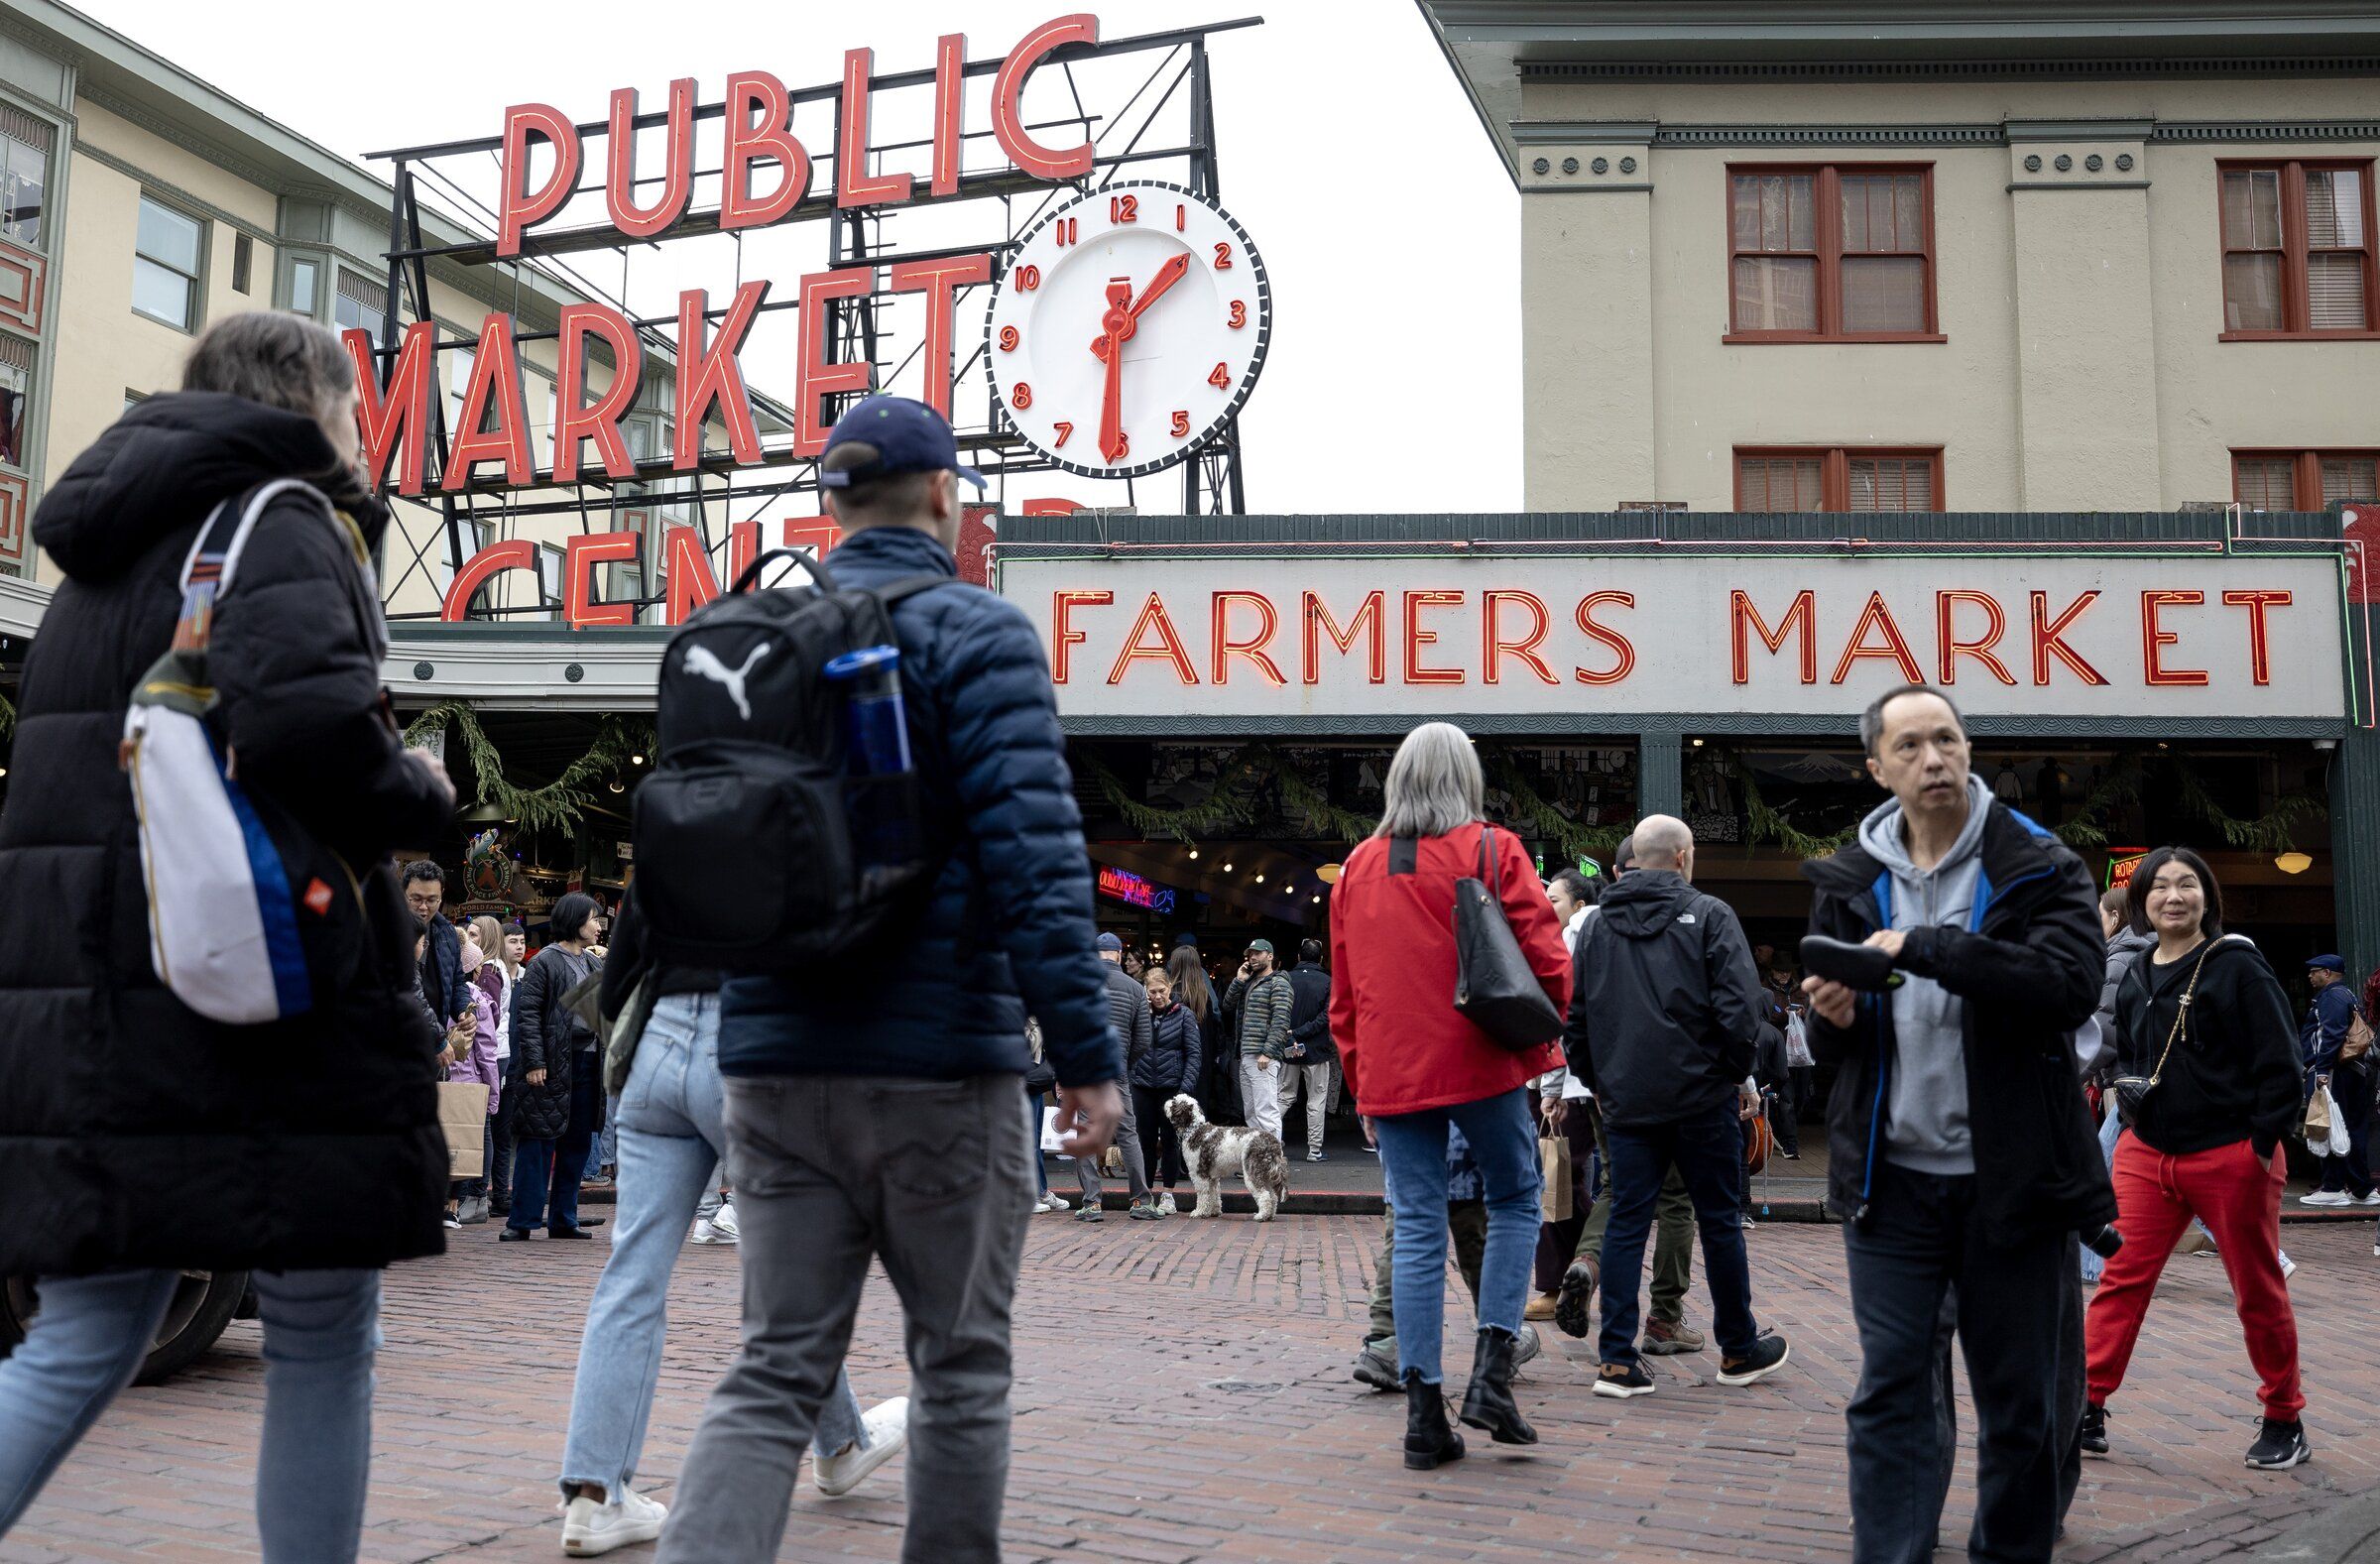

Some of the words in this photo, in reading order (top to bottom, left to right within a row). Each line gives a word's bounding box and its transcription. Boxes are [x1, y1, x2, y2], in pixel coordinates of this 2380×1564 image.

[497, 13, 1100, 257] PUBLIC
[1110, 194, 1138, 223] 12
[1176, 203, 1185, 232] 1
[1056, 217, 1077, 247] 11
[1214, 242, 1233, 271] 2
[1014, 264, 1040, 294] 10
[1227, 300, 1248, 330] 3
[999, 325, 1019, 353] 9
[341, 253, 992, 496] MARKET
[1207, 361, 1232, 391] 4
[1012, 382, 1033, 411] 8
[1053, 421, 1075, 449] 7
[1169, 410, 1190, 437] 5
[1052, 590, 1635, 685] FARMERS
[1730, 589, 2293, 685] MARKET
[461, 903, 485, 912] WORLD
[485, 903, 515, 912] FAMO
